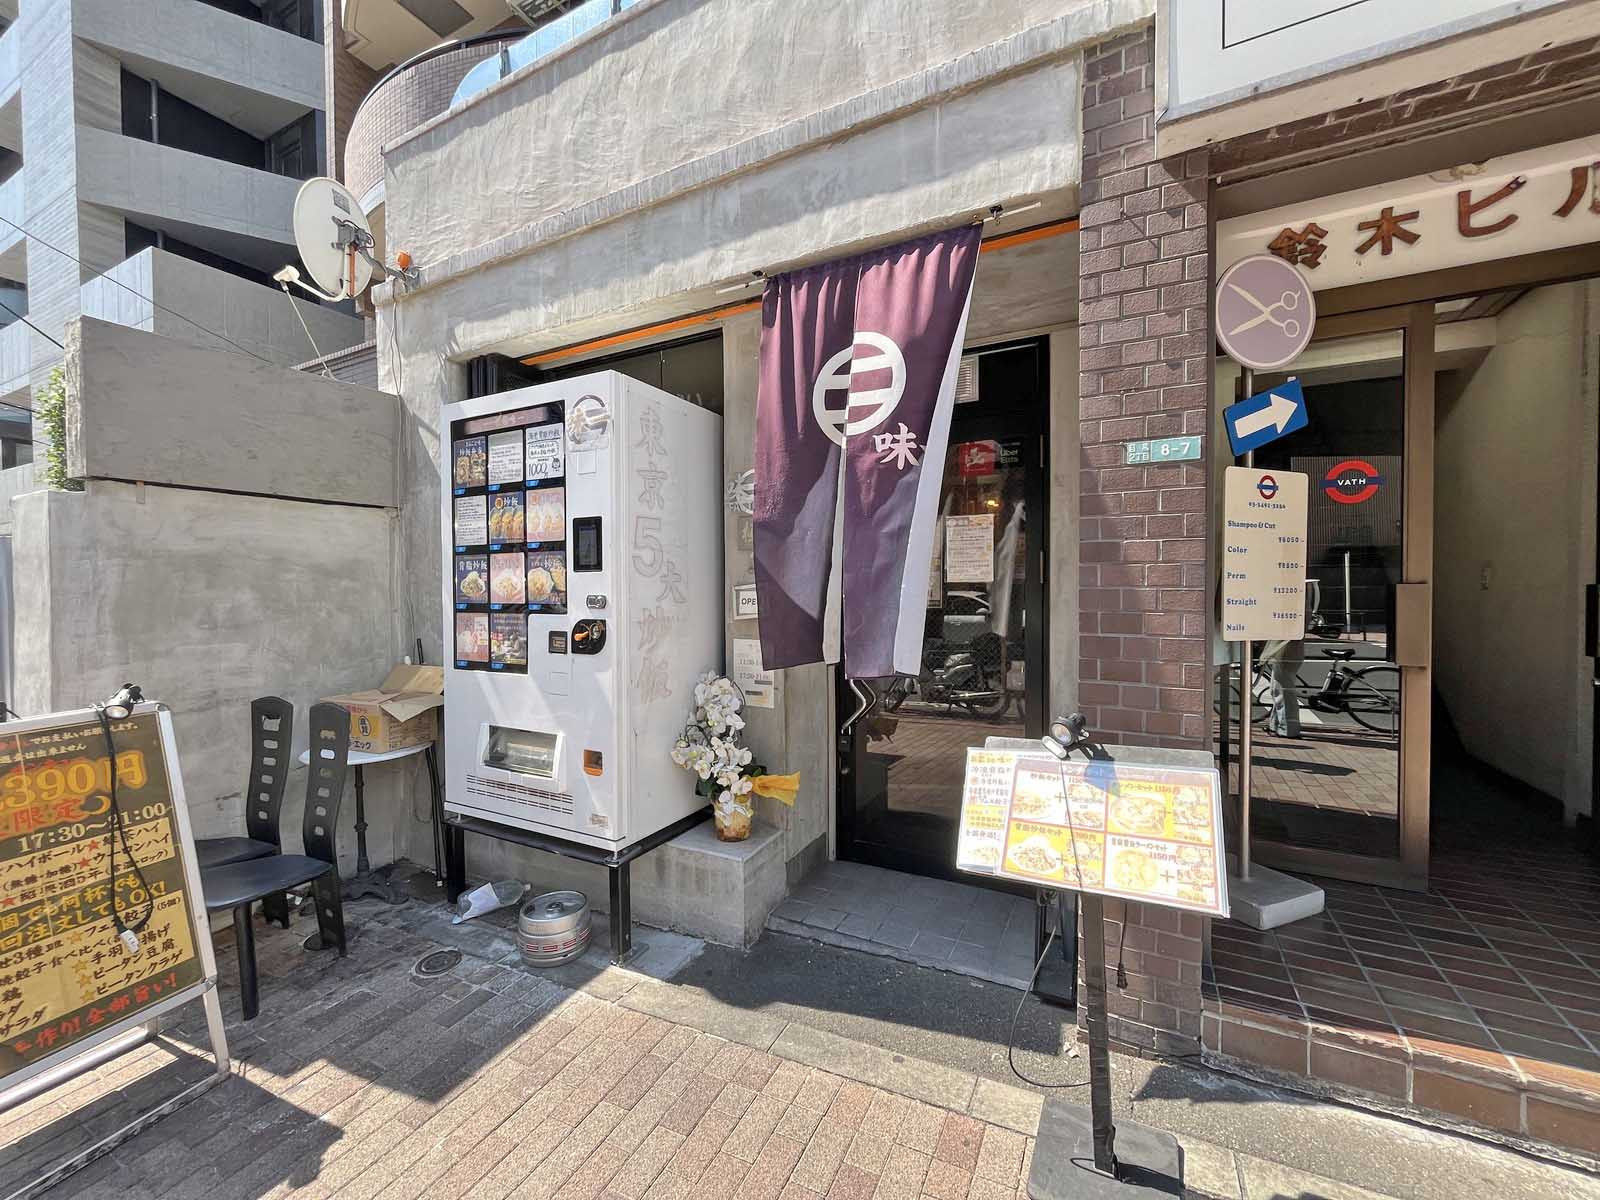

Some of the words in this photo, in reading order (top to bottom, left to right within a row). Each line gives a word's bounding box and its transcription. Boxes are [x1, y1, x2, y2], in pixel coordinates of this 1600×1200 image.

[872, 422, 920, 470] 味
[1161, 442, 1190, 456] 8-7
[1337, 478, 1366, 486] VATH
[741, 597, 756, 606] OPE
[1226, 598, 1257, 606] Straight
[90, 922, 171, 965] 手羽揚げ
